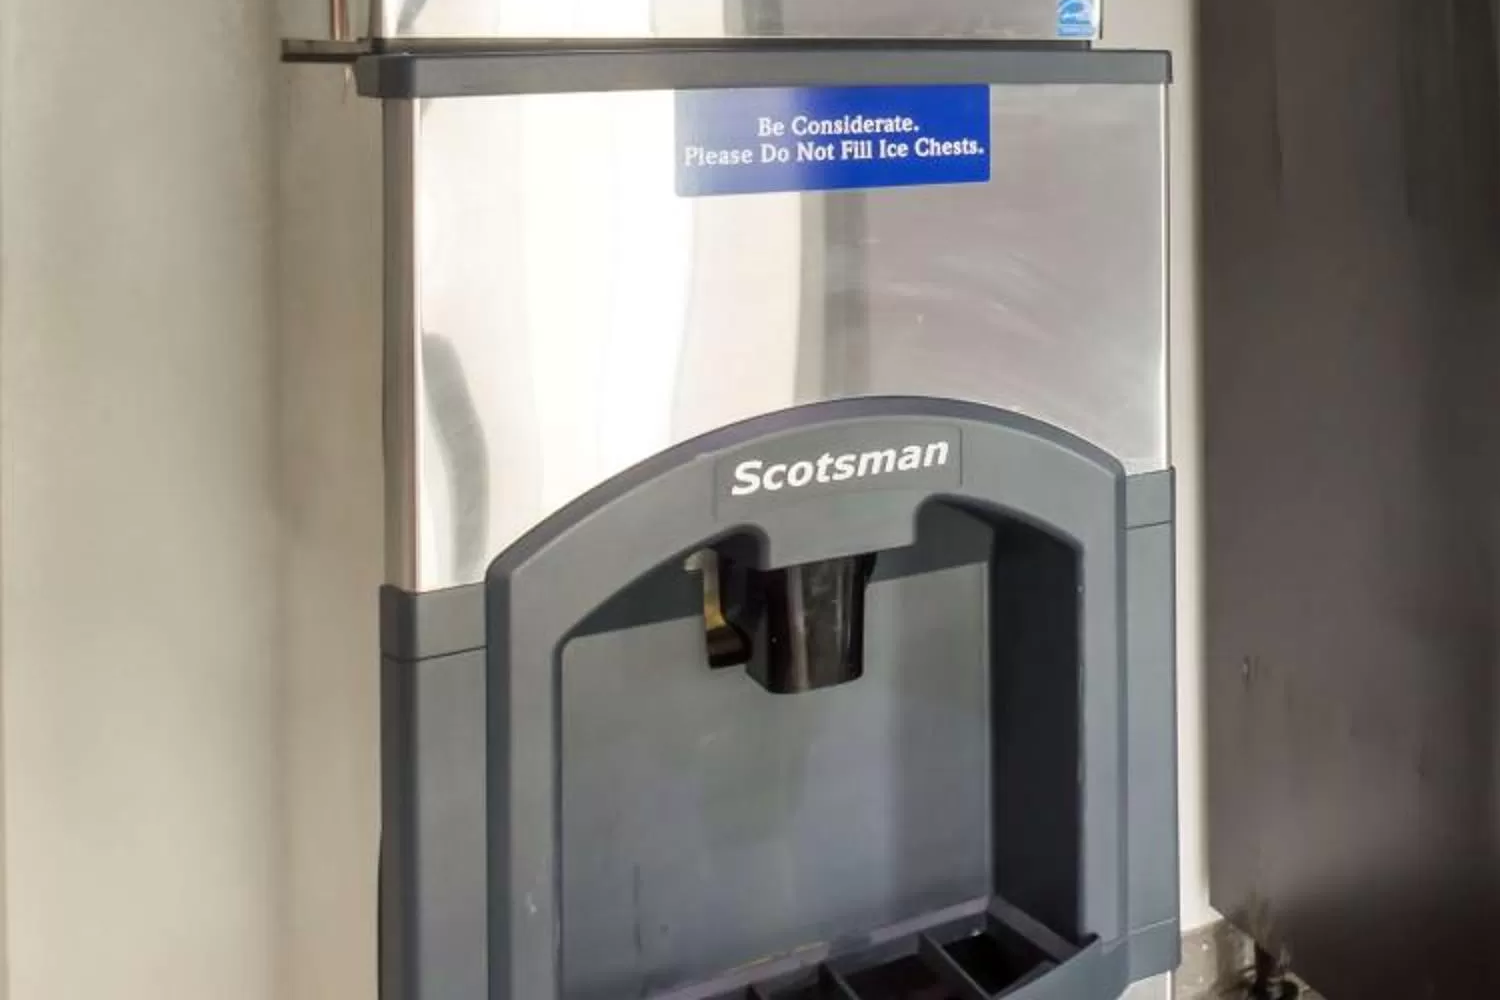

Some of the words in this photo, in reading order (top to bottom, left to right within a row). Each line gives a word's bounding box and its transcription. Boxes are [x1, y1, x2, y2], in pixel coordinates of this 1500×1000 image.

[757, 116, 785, 137] Be
[791, 114, 919, 136] Considerate.
[683, 146, 753, 167] Please
[760, 143, 789, 164] Do
[796, 141, 835, 162] Not
[840, 139, 873, 160] Fill
[879, 138, 909, 159] Ice
[914, 136, 985, 157] Chests.
[731, 440, 949, 496] Scotsman
